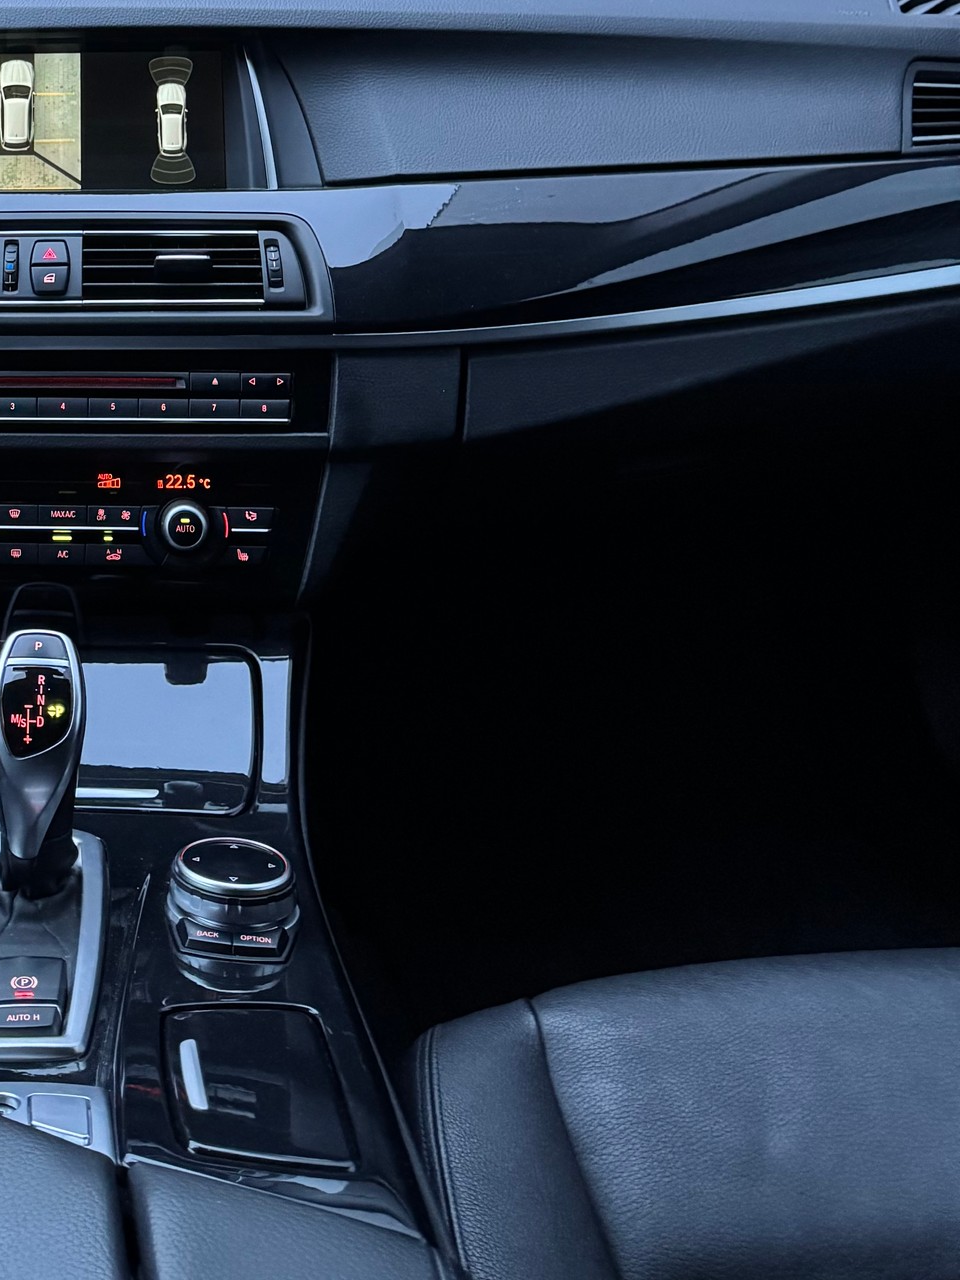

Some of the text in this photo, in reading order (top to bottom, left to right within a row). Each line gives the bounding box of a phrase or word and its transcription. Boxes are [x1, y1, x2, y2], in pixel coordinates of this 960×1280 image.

[10, 402, 15, 410] 3
[60, 402, 66, 410] 4
[110, 402, 116, 410] 5
[161, 403, 166, 411] 6
[212, 404, 216, 412] 7
[262, 404, 267, 412] 8
[166, 474, 196, 488] 22.5
[176, 525, 195, 533] AUTO
[57, 550, 68, 558] A/C
[35, 642, 42, 650] P
[38, 675, 45, 684] R
[37, 694, 45, 706] N
[56, 704, 65, 718] P
[10, 714, 26, 728] M/S
[36, 716, 44, 728] D
[240, 934, 272, 944] OPTION
